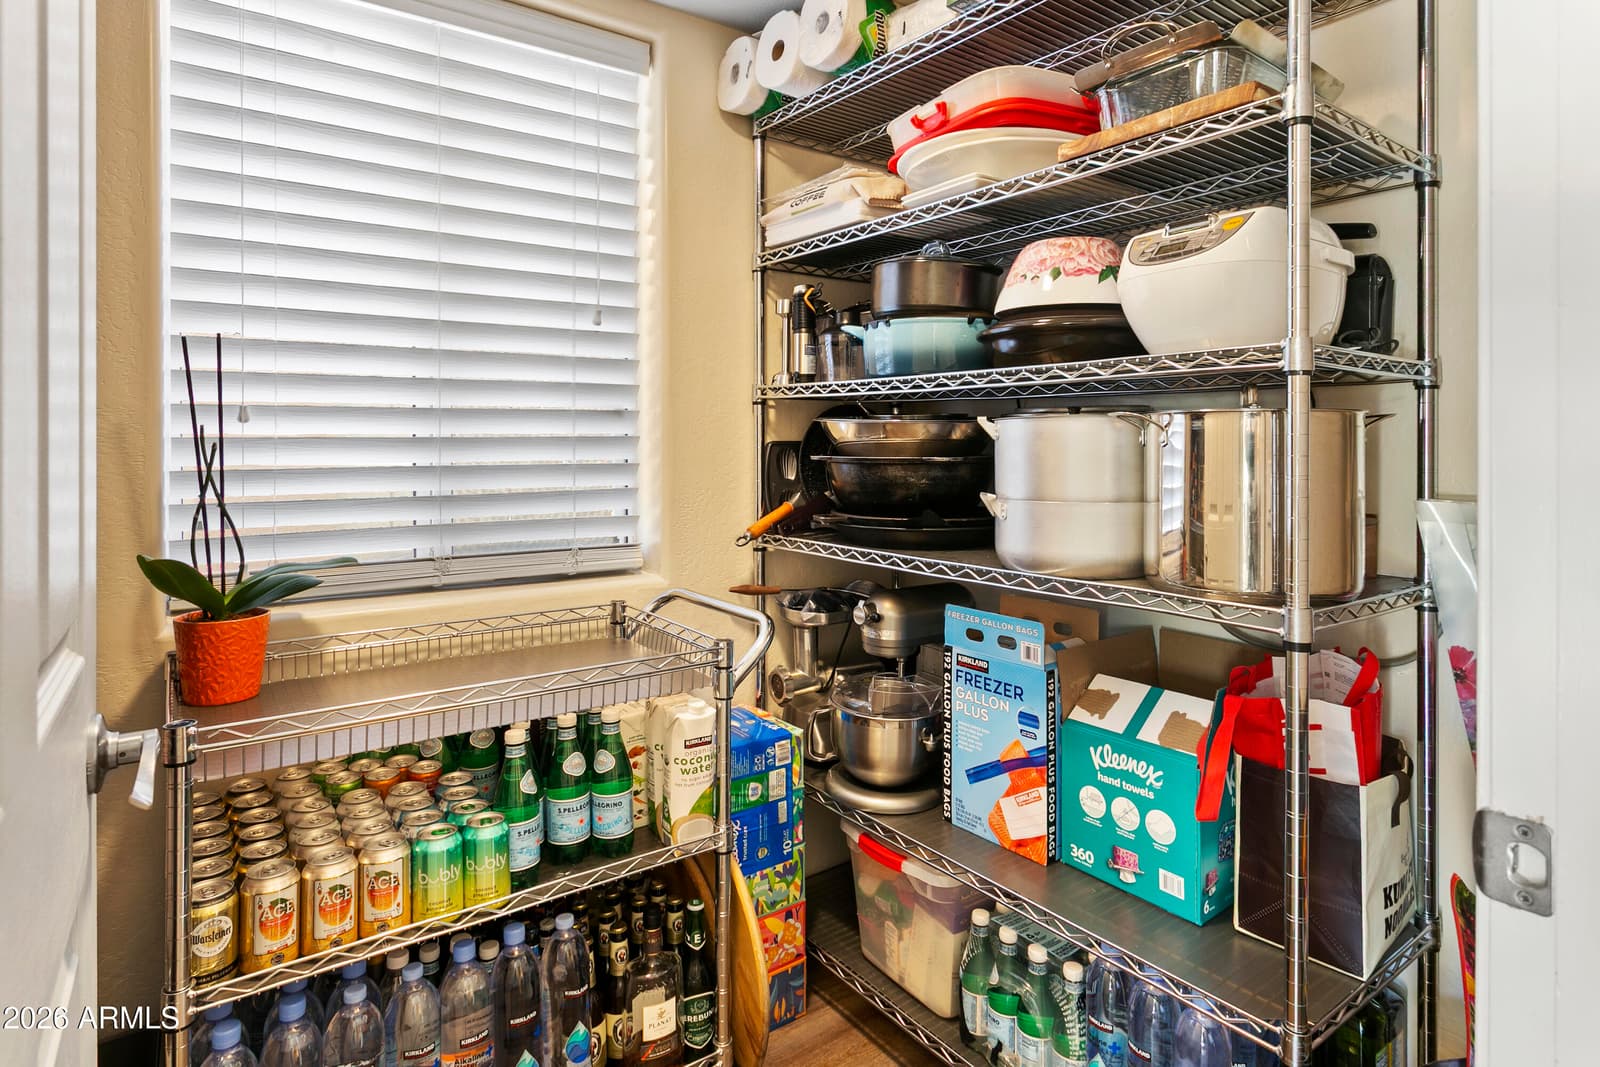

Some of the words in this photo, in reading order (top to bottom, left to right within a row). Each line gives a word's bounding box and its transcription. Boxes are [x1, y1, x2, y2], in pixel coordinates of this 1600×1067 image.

[872, 10, 886, 58] Bounty
[947, 610, 980, 624] FREEZER
[981, 618, 1014, 631] GALLON
[1016, 625, 1039, 637] BAGS
[943, 651, 952, 670] 192
[957, 654, 989, 669] KIRKLAND
[956, 669, 1024, 702] FREEZER
[1047, 679, 1055, 697] 192
[943, 674, 952, 719] GALLON
[956, 686, 1010, 713] GALLON
[956, 700, 989, 722] PLUS
[943, 721, 951, 750] PLUS
[1047, 702, 1056, 751] GALLON
[673, 753, 715, 766] cocon
[943, 751, 951, 786] FOOD
[1048, 754, 1056, 784] PLUS
[1089, 743, 1164, 788] Kleenex
[1097, 771, 1121, 788] hand
[1122, 782, 1155, 800] towels
[593, 801, 623, 809] LLEGRINO
[943, 787, 951, 819] BAGS
[1048, 787, 1056, 823] FOOD
[783, 839, 792, 855] 10
[1048, 826, 1056, 858] BAGS
[465, 852, 507, 870] bubly
[1070, 843, 1094, 865] 360
[368, 872, 400, 890] ACE
[418, 863, 461, 884] bubly
[320, 886, 353, 907] ACE
[1203, 900, 1210, 914] 6
[261, 899, 296, 922] ACE
[192, 925, 232, 946] Warsteiner
[564, 984, 589, 996] KIRKLAND
[510, 1010, 537, 1025] KIRKLAND
[1089, 1014, 1113, 1031] LAND
[461, 1030, 489, 1045] KIRKLAND
[404, 1043, 435, 1057] KIRKLAND
[1128, 1039, 1151, 1059] LAND
